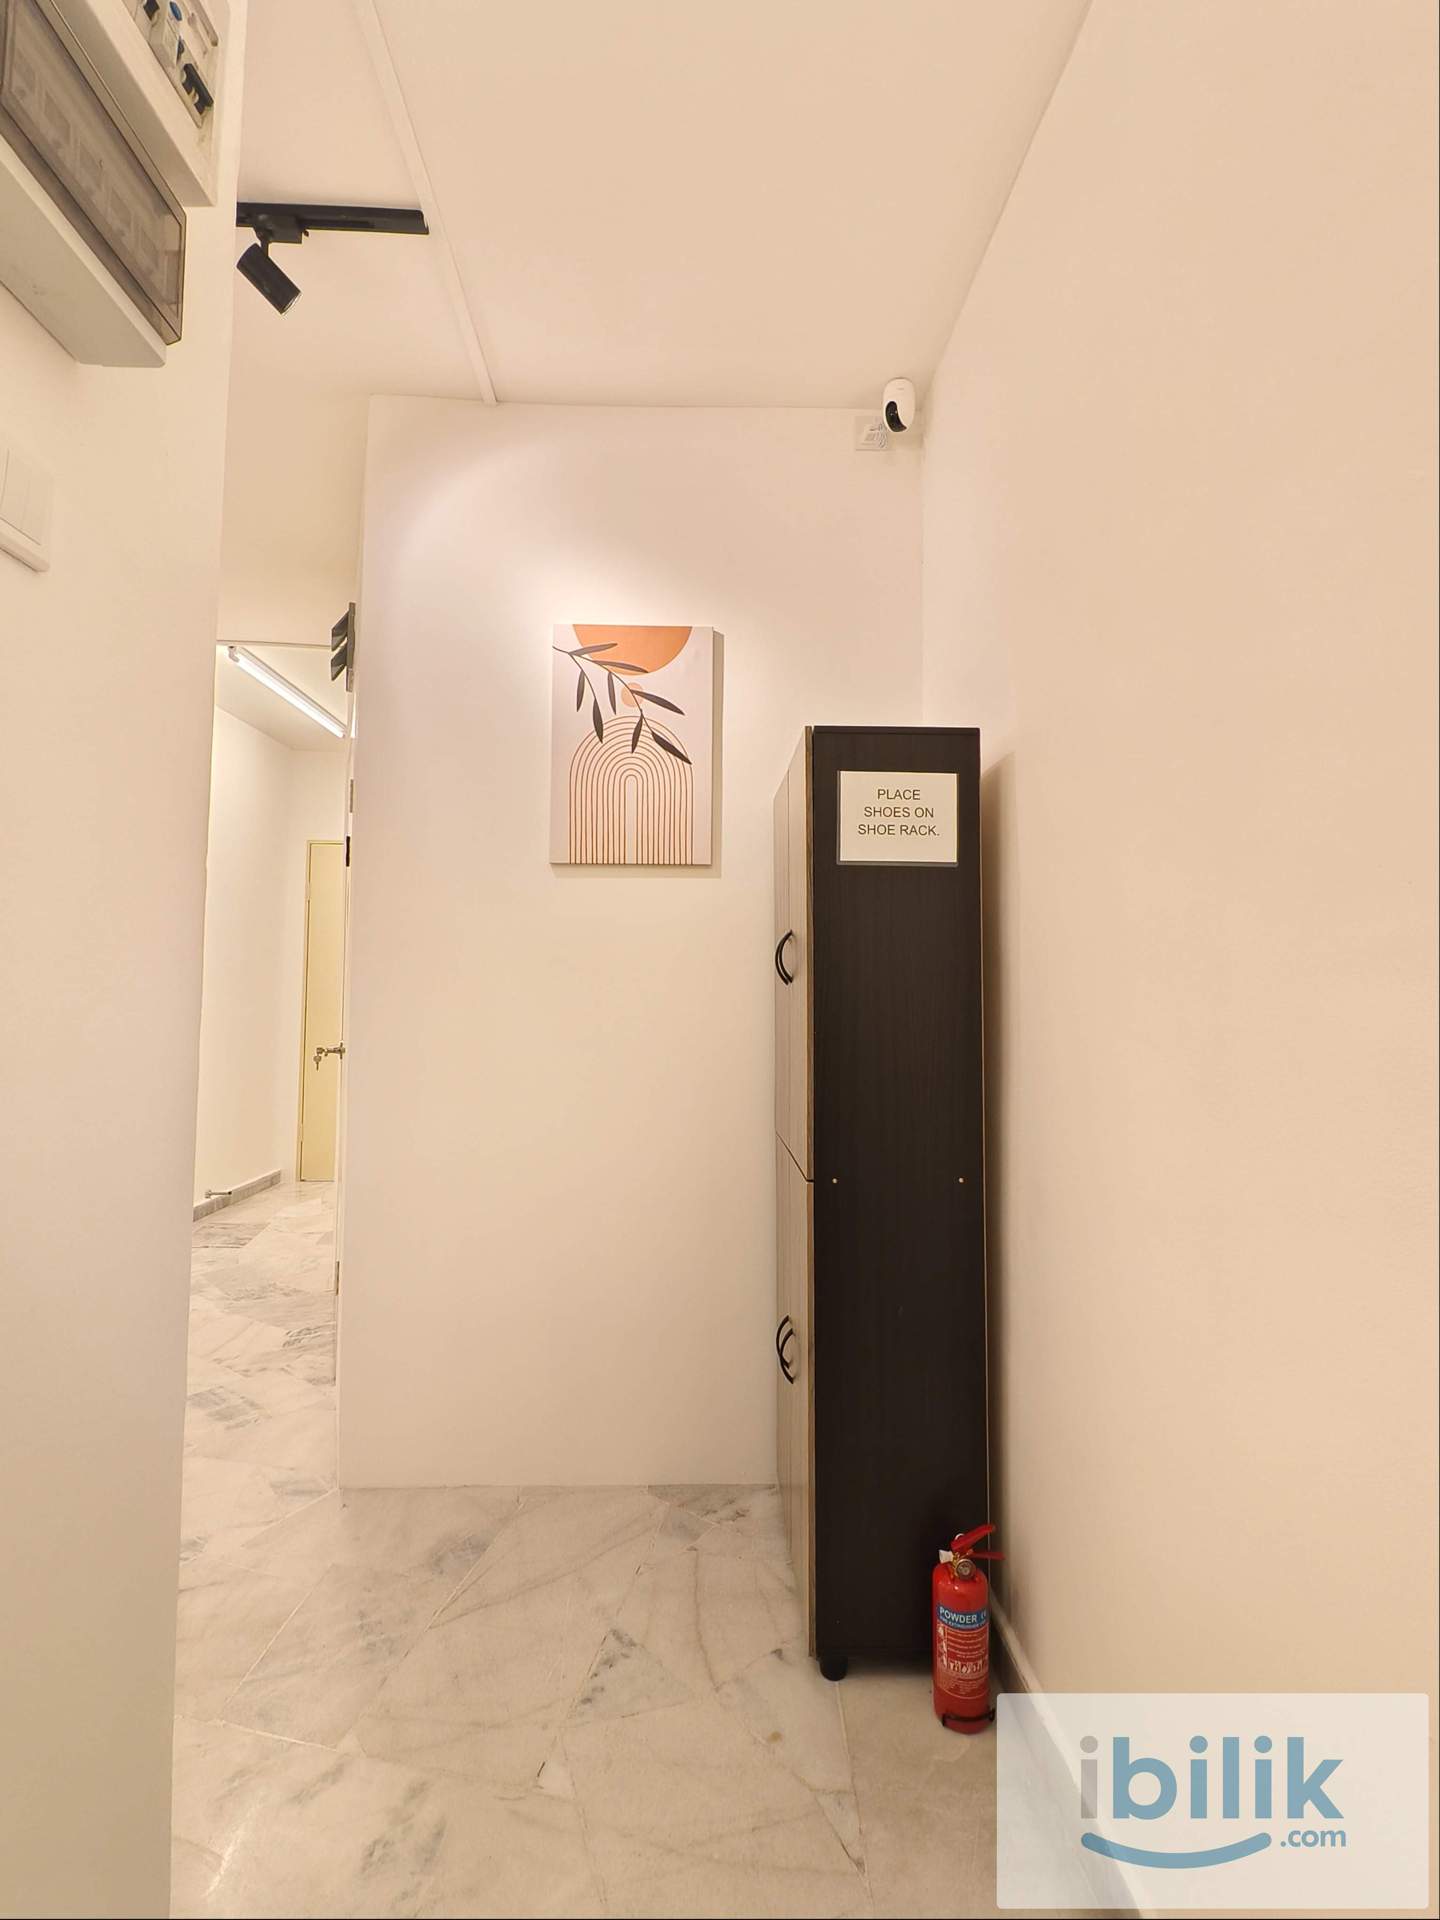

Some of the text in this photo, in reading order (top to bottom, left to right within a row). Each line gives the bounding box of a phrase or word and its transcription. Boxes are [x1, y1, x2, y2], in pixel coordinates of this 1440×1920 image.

[877, 788, 921, 801] PLACE
[864, 806, 935, 818] SHOES ON
[857, 823, 940, 837] SHOE RACK.
[939, 1606, 978, 1624] POWDER
